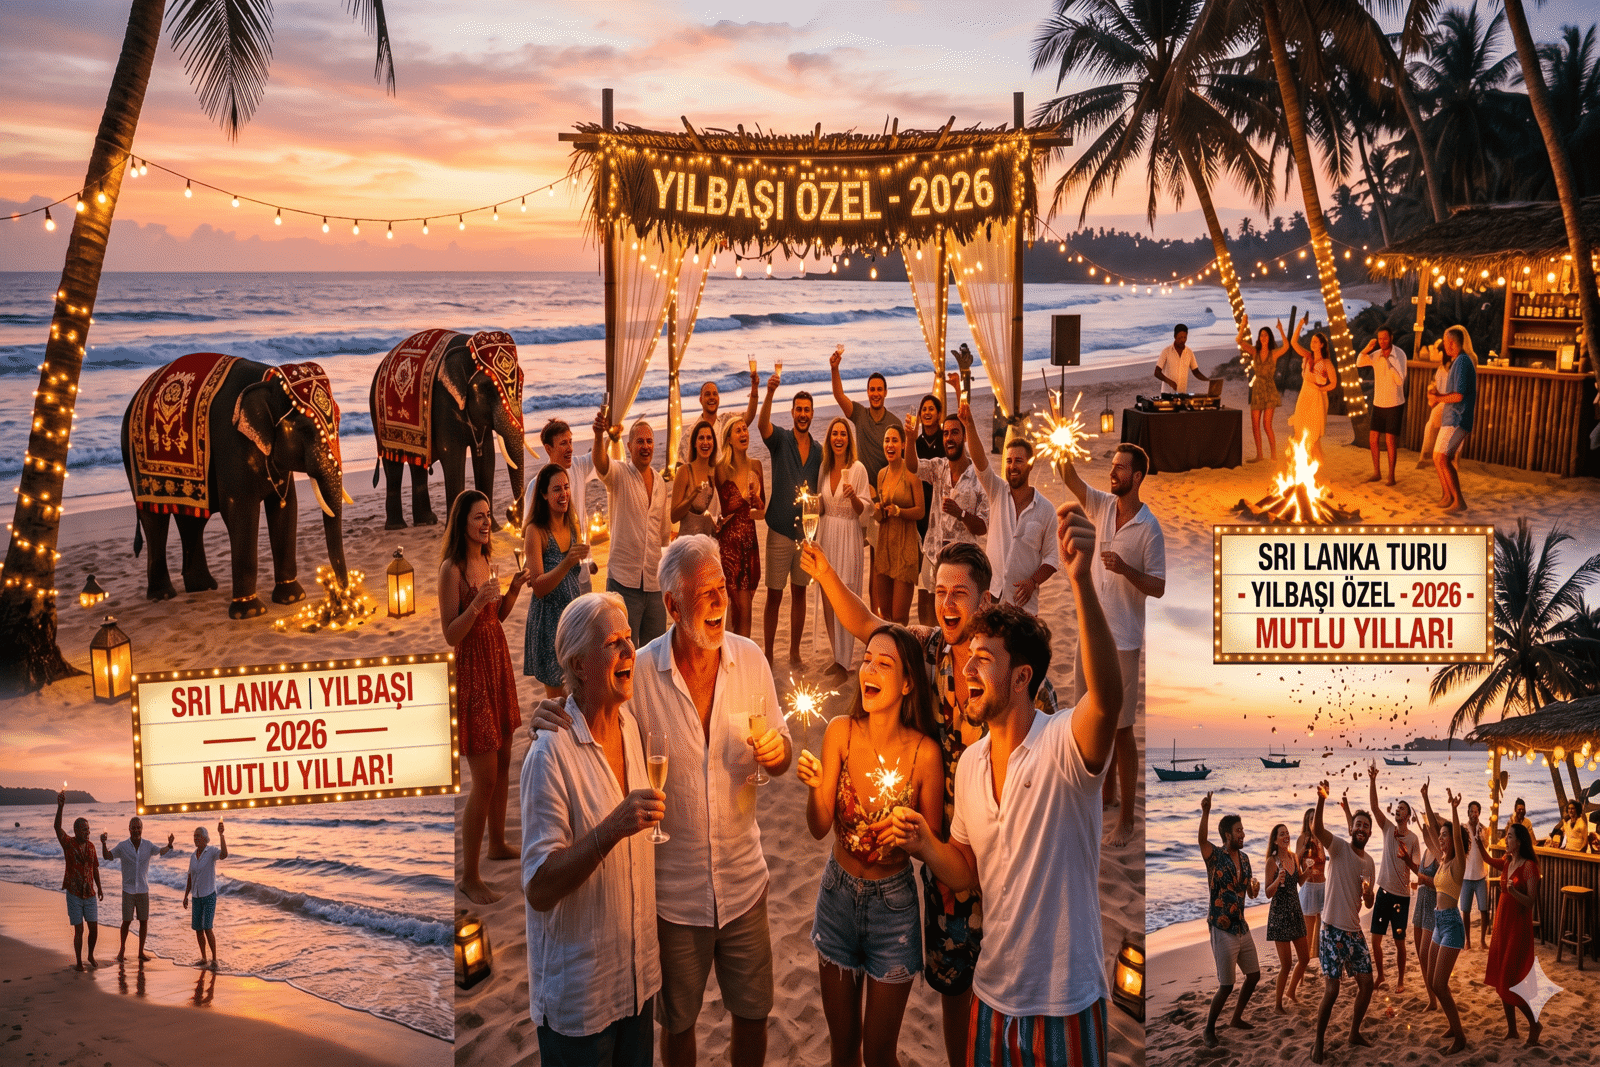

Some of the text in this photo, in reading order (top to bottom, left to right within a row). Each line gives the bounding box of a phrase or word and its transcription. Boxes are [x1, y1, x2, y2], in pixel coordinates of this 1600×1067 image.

[653, 169, 785, 230] YILBAŞI
[796, 173, 882, 221] ÖZEL
[909, 168, 995, 216] 2026
[1258, 543, 1447, 571] SRI LANKA TURU
[1251, 581, 1335, 614] YILBAŞI
[1342, 575, 1395, 608] ÖZEL
[1412, 582, 1462, 608] 2026
[1256, 617, 1453, 649] MUTLU YILLAR!
[171, 685, 211, 718] SRI
[219, 679, 302, 714] LANKA
[318, 671, 414, 711] YILBAŞI
[265, 718, 328, 752] 2026
[203, 753, 394, 796] MUTLU YILLAR!
